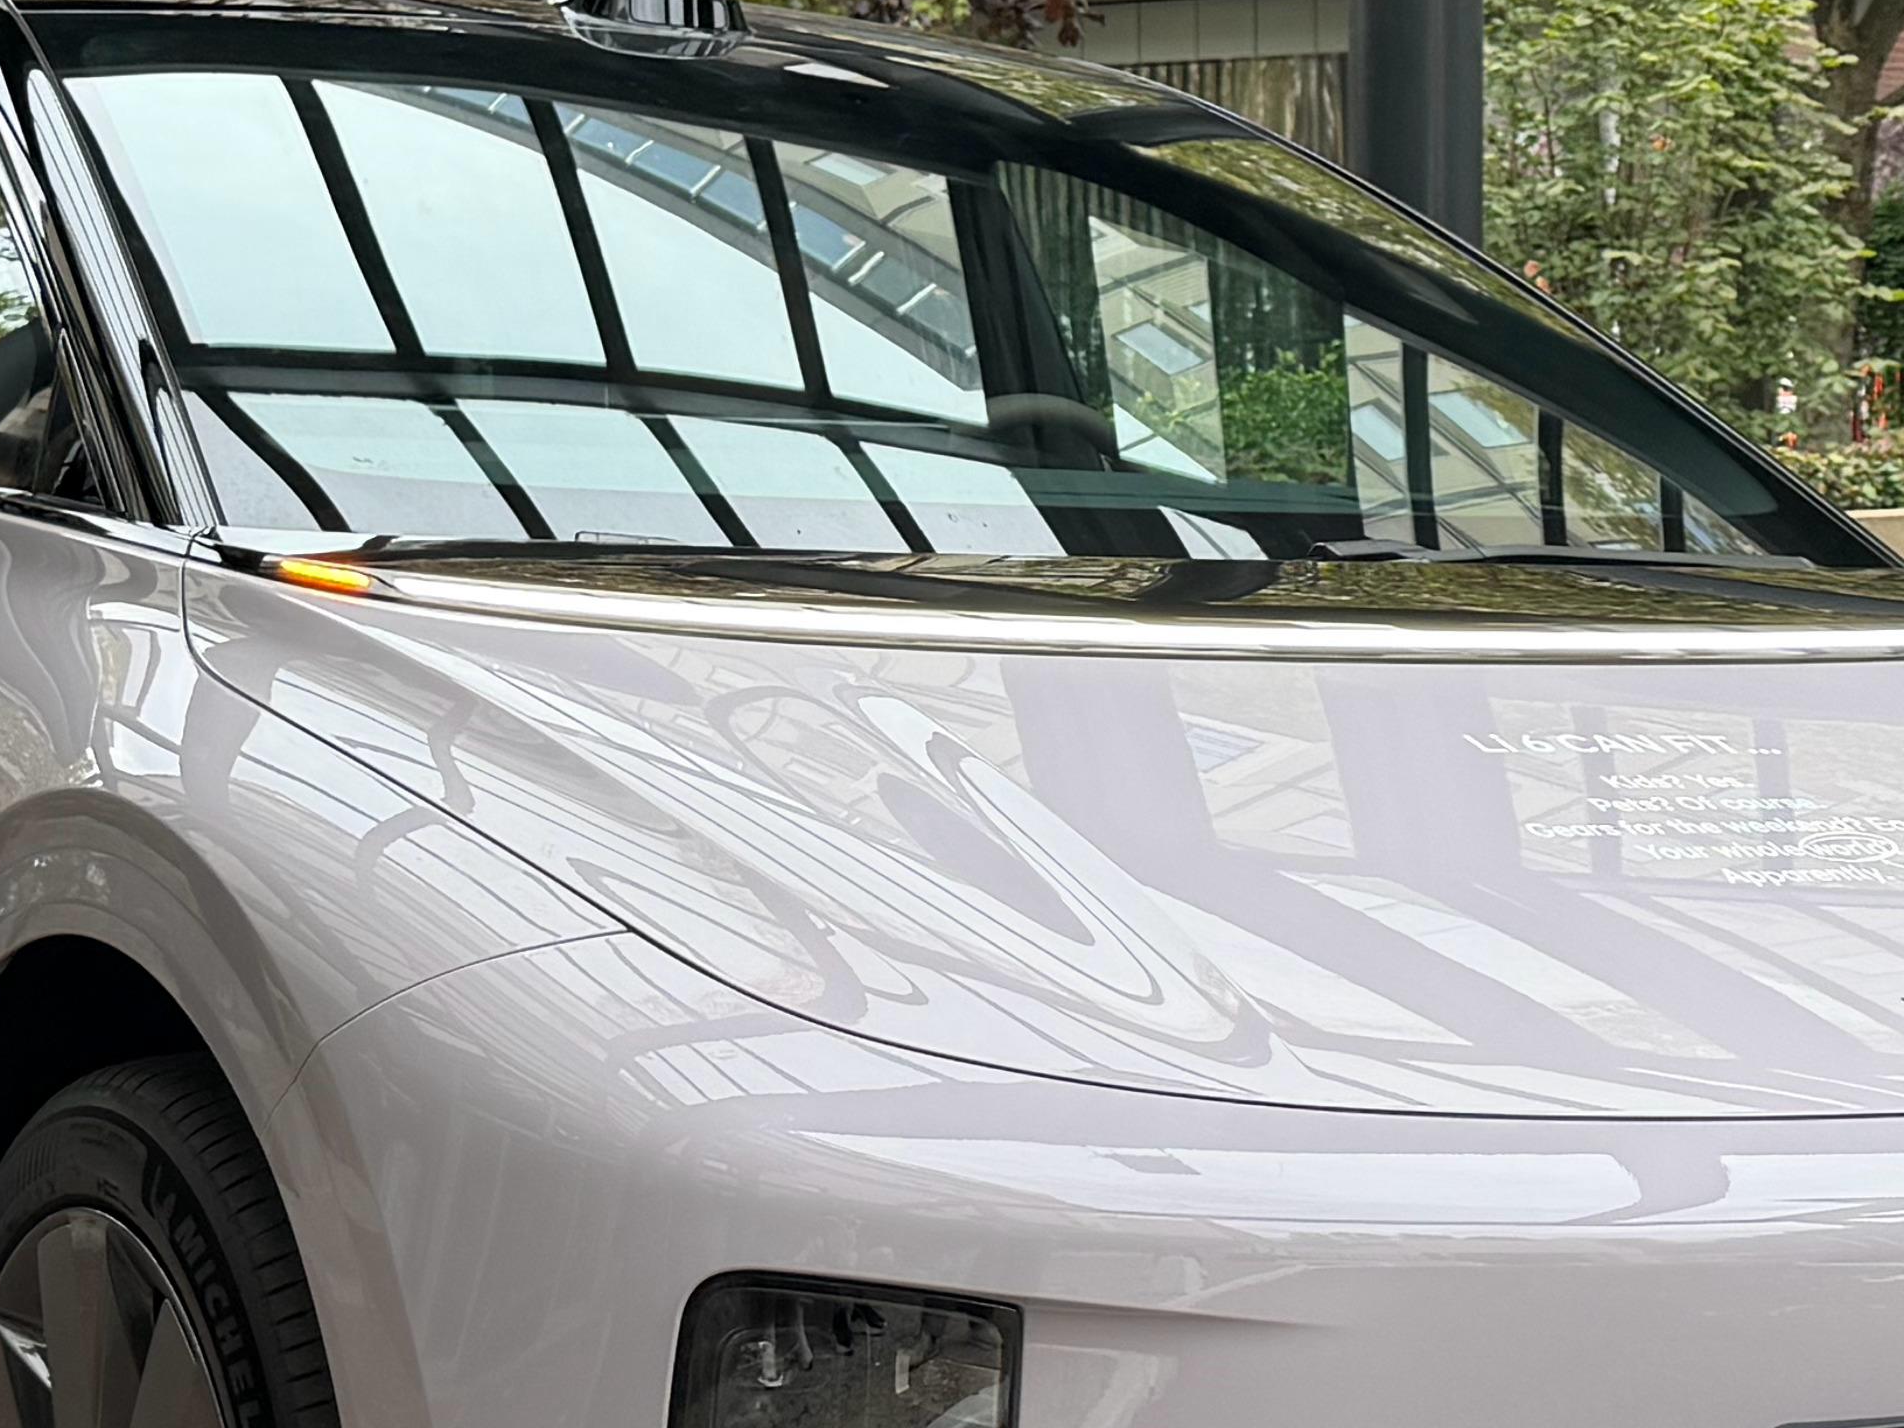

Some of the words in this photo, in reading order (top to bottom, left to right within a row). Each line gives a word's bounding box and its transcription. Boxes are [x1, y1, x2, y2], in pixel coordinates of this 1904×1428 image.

[1522, 732, 1556, 754] 6
[1556, 732, 1667, 754] CAN
[1618, 819, 1666, 837] for
[1665, 818, 1723, 835] the
[1633, 843, 1711, 861] Your
[1711, 839, 1807, 859] whole
[1721, 865, 1896, 888] Apparently.
